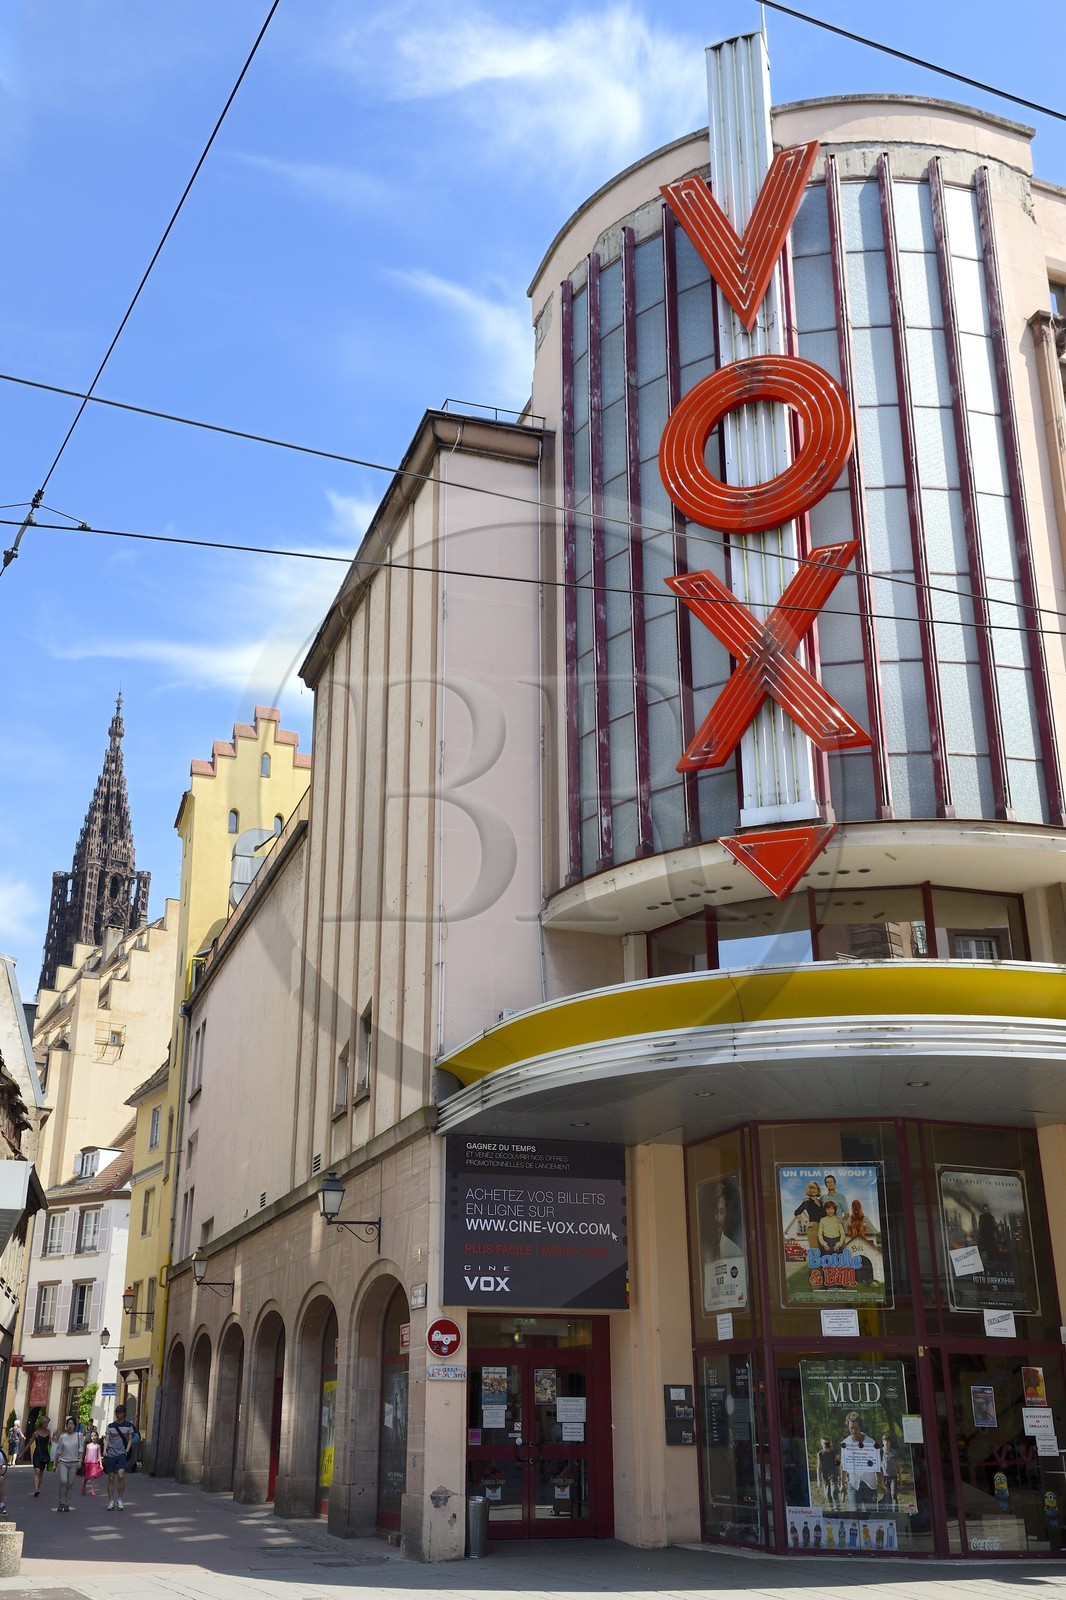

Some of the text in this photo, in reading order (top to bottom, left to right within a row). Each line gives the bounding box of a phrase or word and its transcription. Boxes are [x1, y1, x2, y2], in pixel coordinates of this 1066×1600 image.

[658, 138, 873, 774] VOX
[466, 1142, 537, 1153] GAGNEZ DU TEMPS
[475, 1151, 494, 1159] VENEZ
[466, 1159, 525, 1168] PROMOTIONNELLES
[535, 1162, 570, 1171] LANCEMENT
[838, 1169, 866, 1177] WOUF
[465, 1188, 606, 1206] ACHETEZ VOS BILLETS
[465, 1203, 555, 1218] EN LIGNE SUR
[465, 1218, 611, 1236] WWW.CINE-VOX.COM
[465, 1243, 493, 1255] PLUS
[495, 1244, 533, 1256] FACILE
[807, 1247, 863, 1270] Boule
[464, 1276, 511, 1292] VOX
[822, 1266, 858, 1288] Bill
[826, 1381, 881, 1403] MUD
